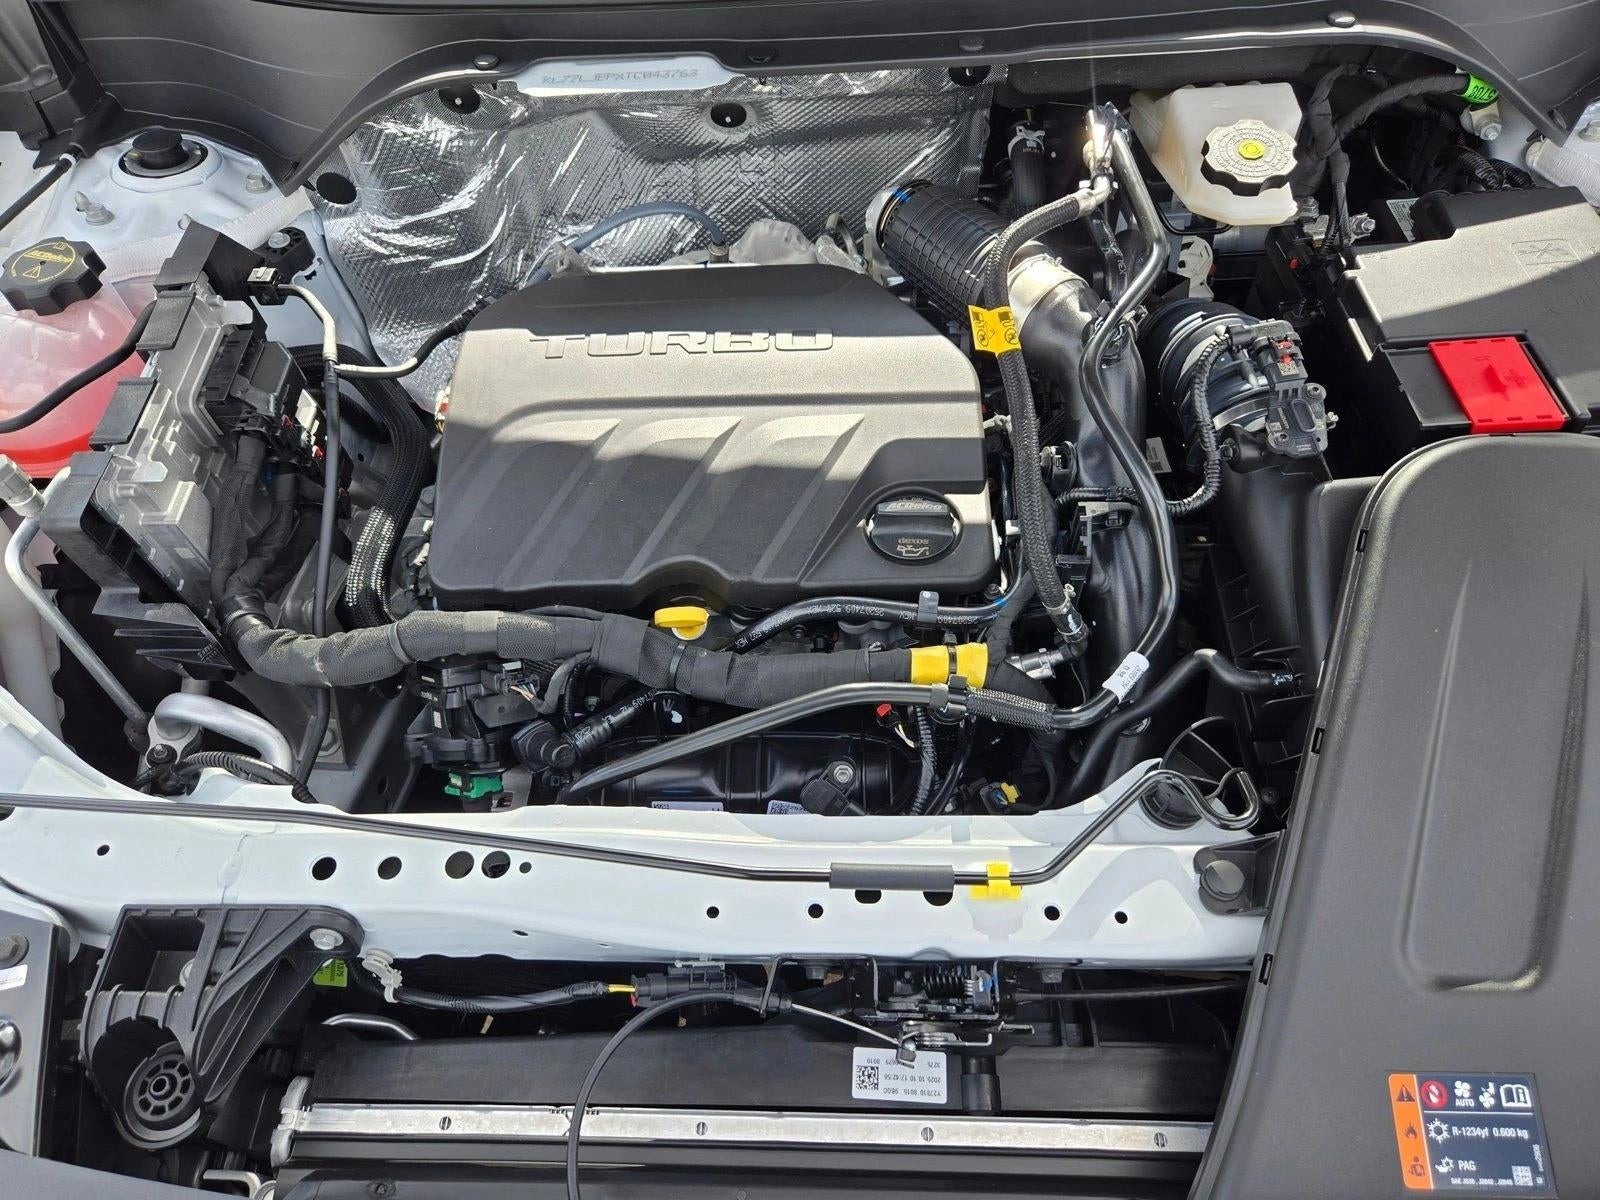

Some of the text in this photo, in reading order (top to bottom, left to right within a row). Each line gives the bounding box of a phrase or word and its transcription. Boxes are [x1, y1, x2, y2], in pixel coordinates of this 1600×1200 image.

[529, 329, 834, 359] TURBO
[885, 502, 942, 511] ACDelco
[898, 537, 929, 545] dexos
[1455, 1098, 1475, 1107] AUTO
[1452, 1126, 1528, 1138] R-1234yf 0.600 kg
[1458, 1160, 1476, 1171] PAG
